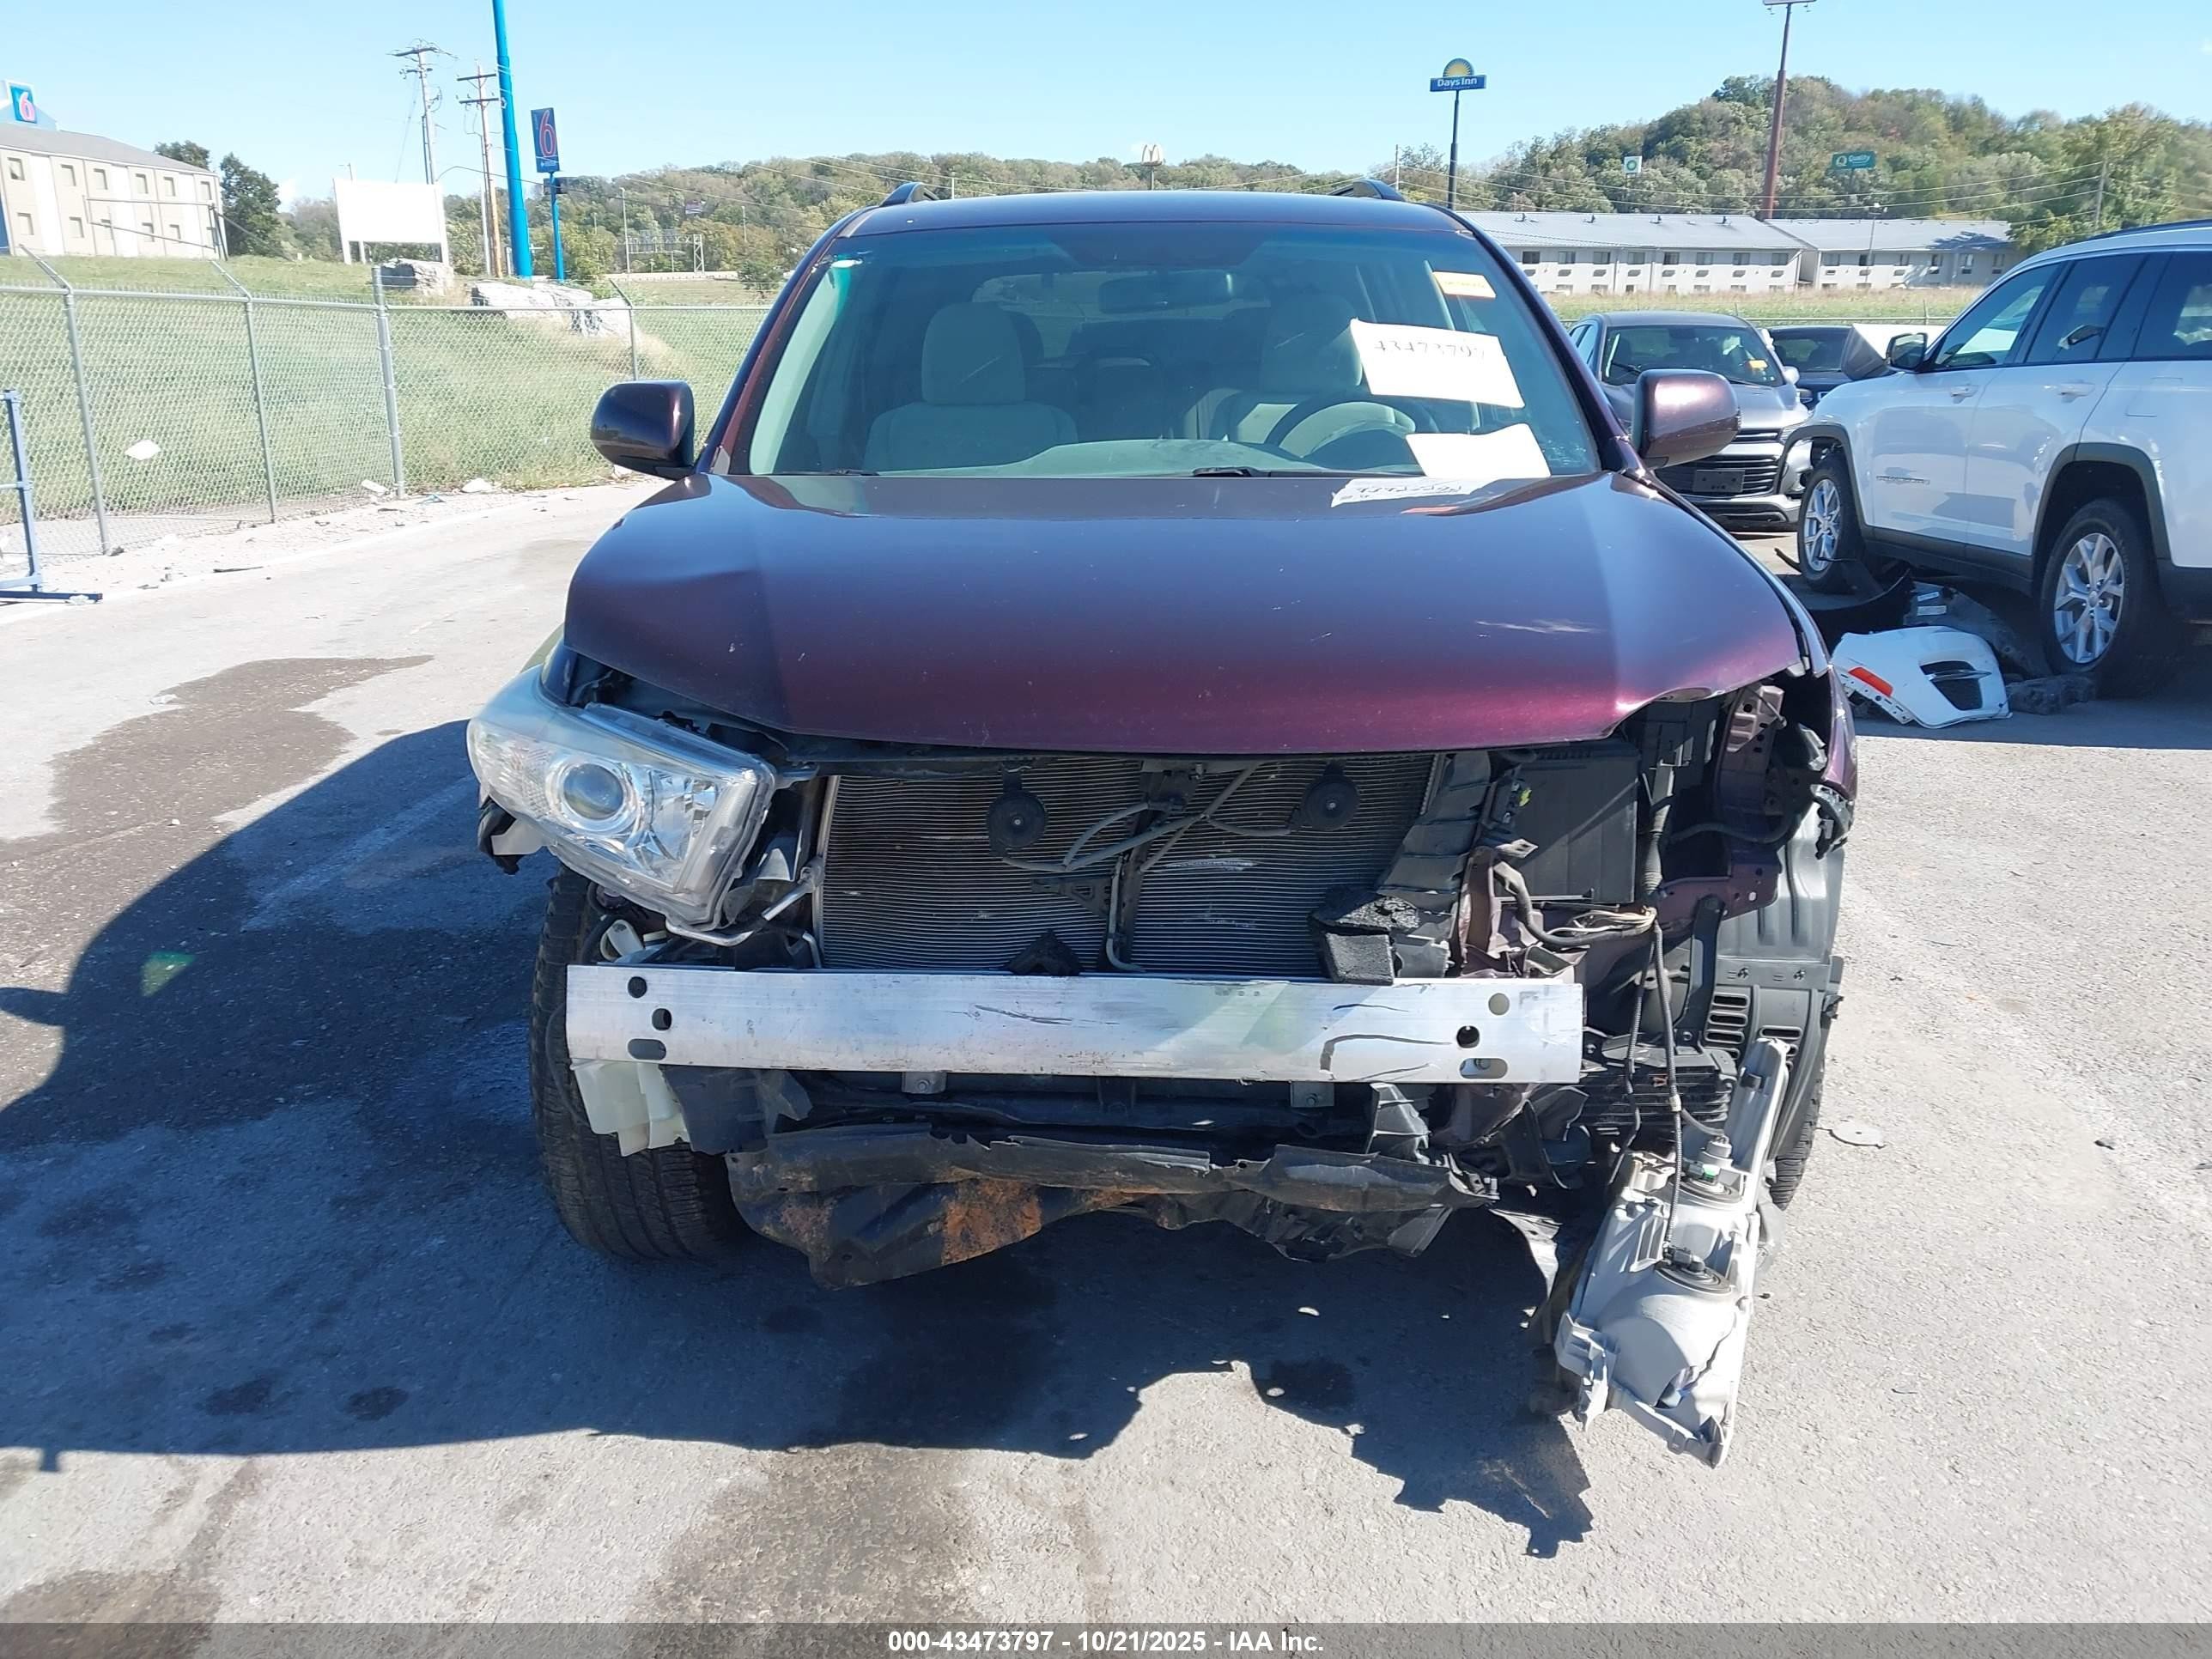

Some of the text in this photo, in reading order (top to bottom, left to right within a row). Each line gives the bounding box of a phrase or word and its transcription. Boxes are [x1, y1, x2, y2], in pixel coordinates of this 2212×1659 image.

[1437, 78, 1460, 88] Days
[19, 91, 35, 121] 6
[538, 109, 556, 158] 6
